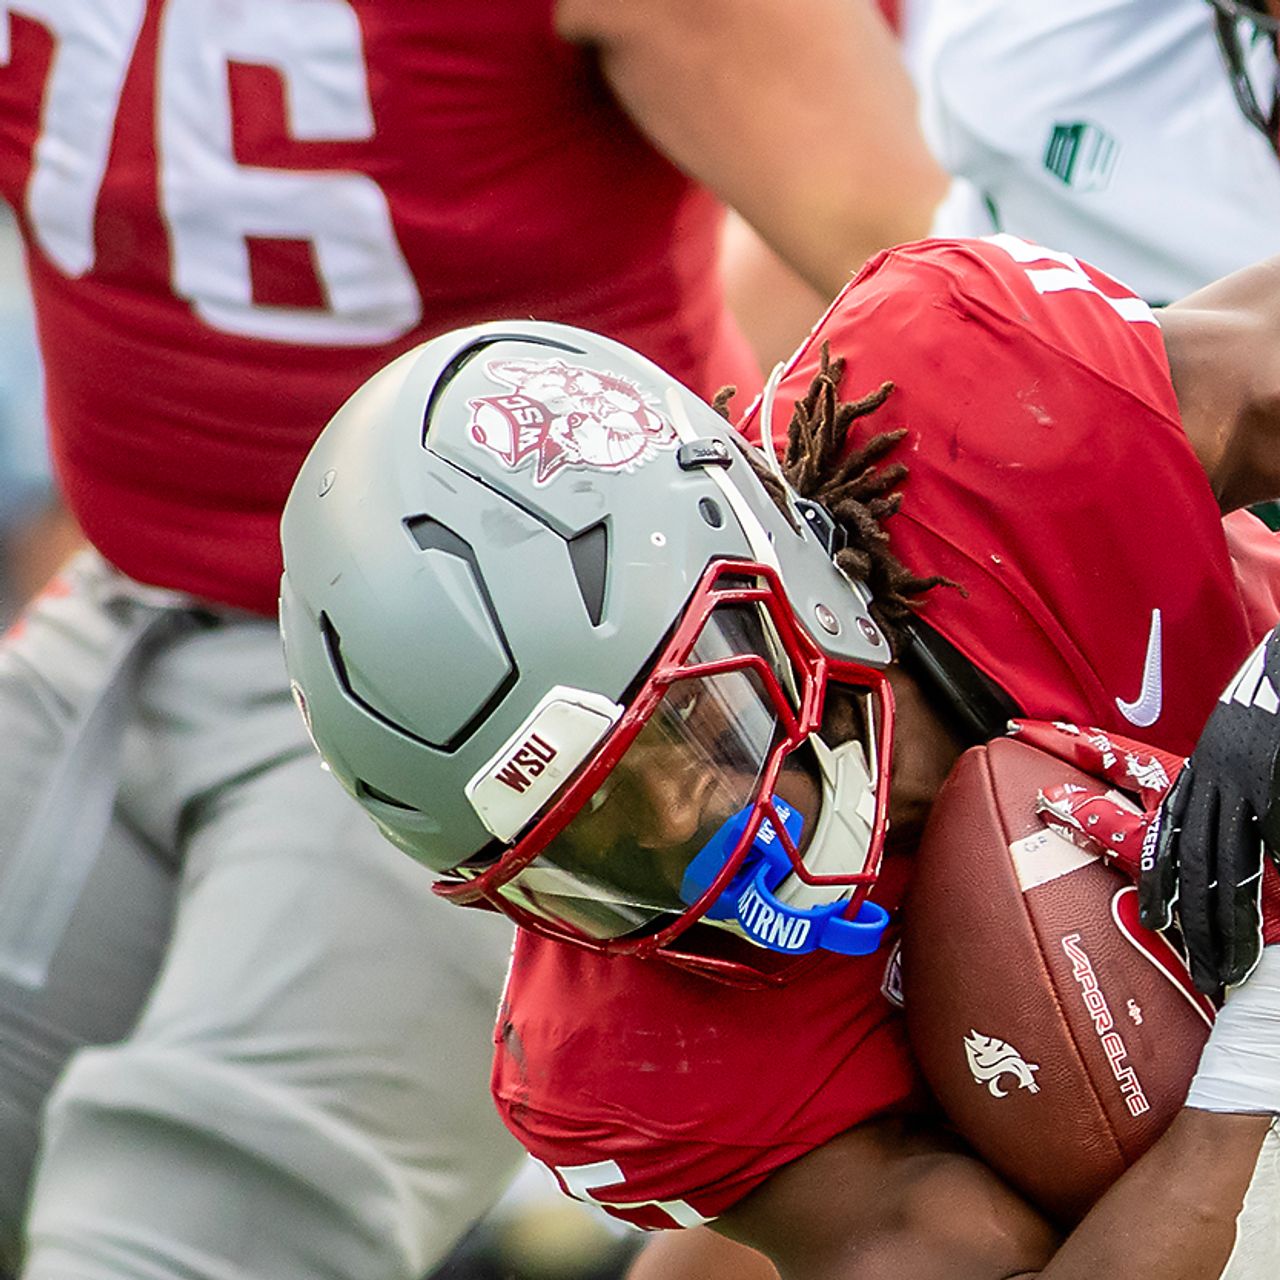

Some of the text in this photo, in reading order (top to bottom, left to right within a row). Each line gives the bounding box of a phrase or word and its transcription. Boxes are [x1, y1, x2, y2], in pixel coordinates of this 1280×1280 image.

[0, 0, 422, 347] 76
[495, 732, 558, 793] WSU
[1062, 933, 1150, 1118] VAPOR ELITE
